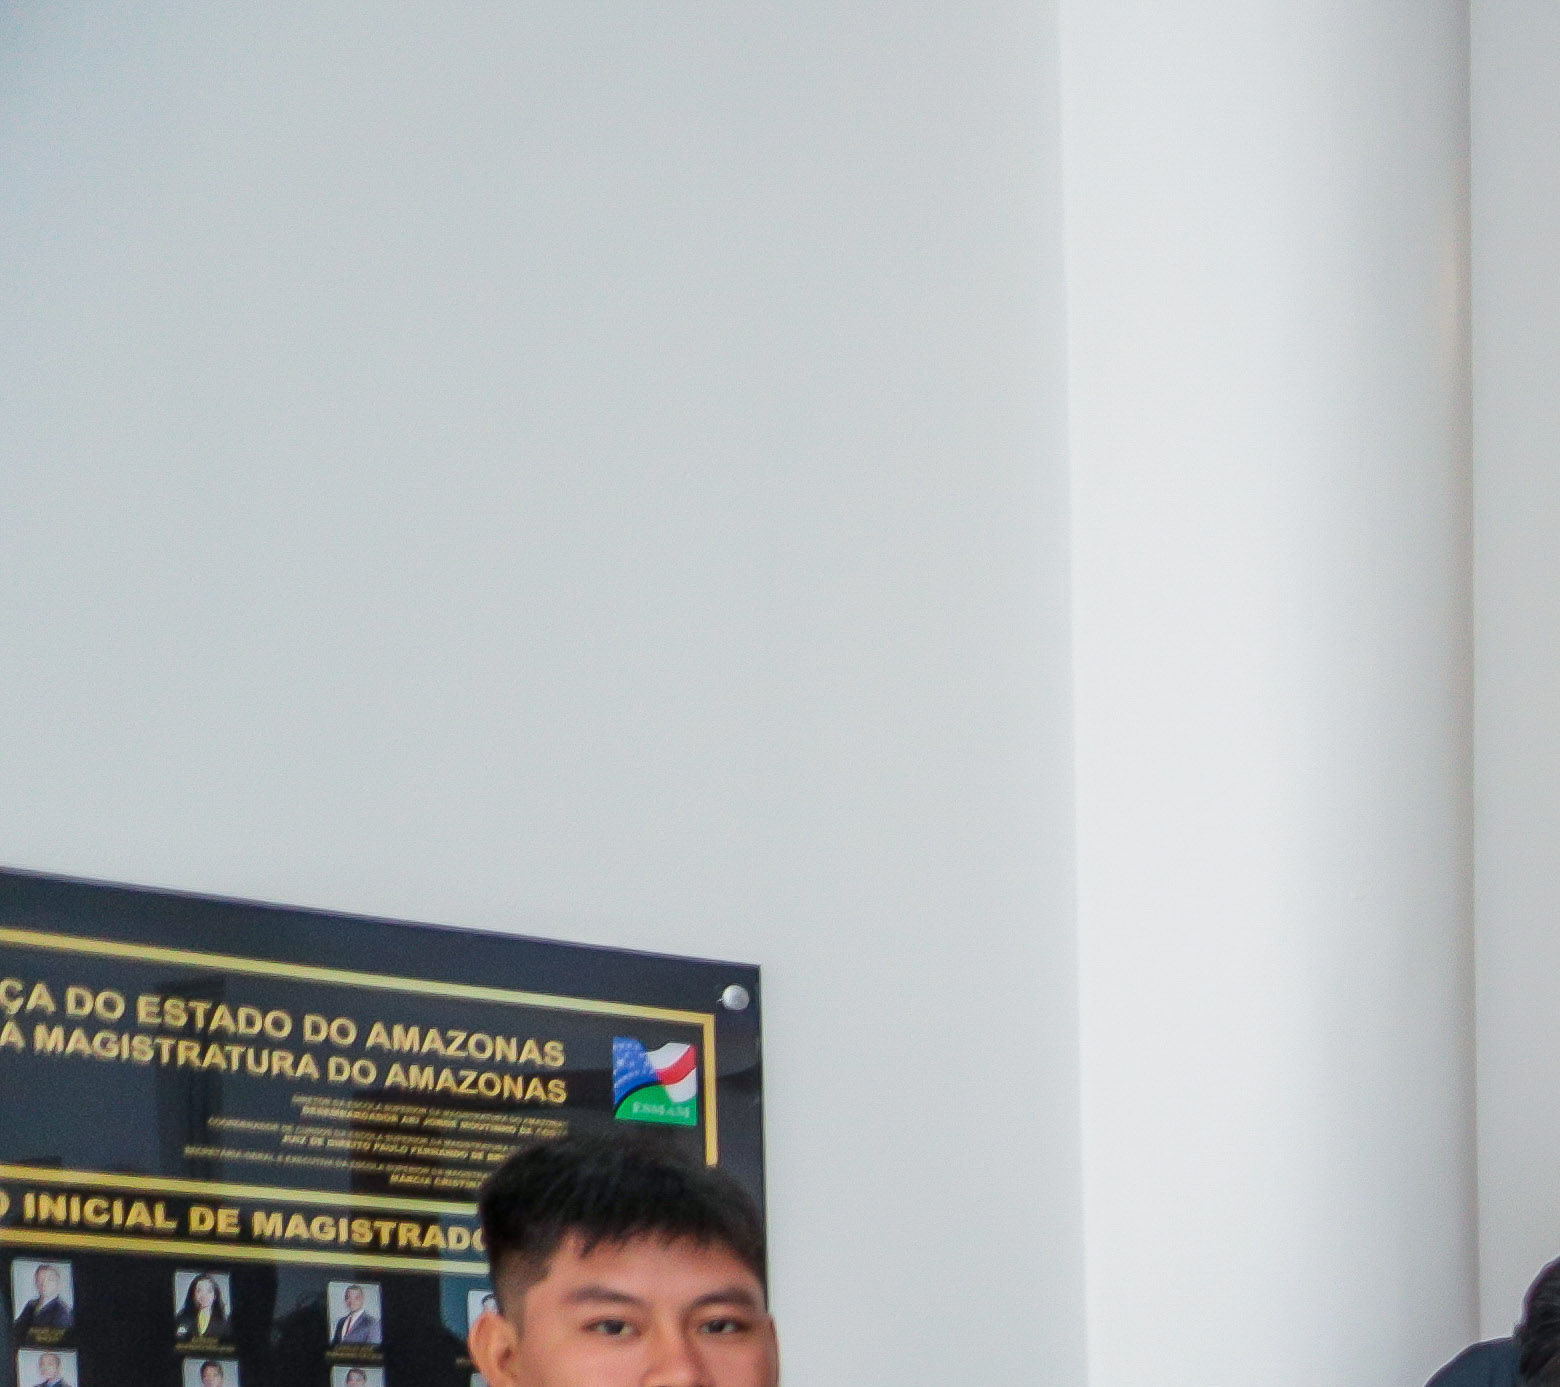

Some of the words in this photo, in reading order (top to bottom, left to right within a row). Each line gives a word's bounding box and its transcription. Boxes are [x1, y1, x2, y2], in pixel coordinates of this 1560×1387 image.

[33, 1023, 320, 1081] MAGISTRATURA
[327, 1055, 377, 1085] DO
[384, 1063, 568, 1103] AMAZONAS
[65, 985, 127, 1022] DO
[136, 994, 293, 1040] ESTADO
[303, 1013, 358, 1046] DO
[365, 1020, 566, 1067] AMAZONAS
[23, 1192, 178, 1231] INICIAL
[188, 1205, 241, 1236] DE
